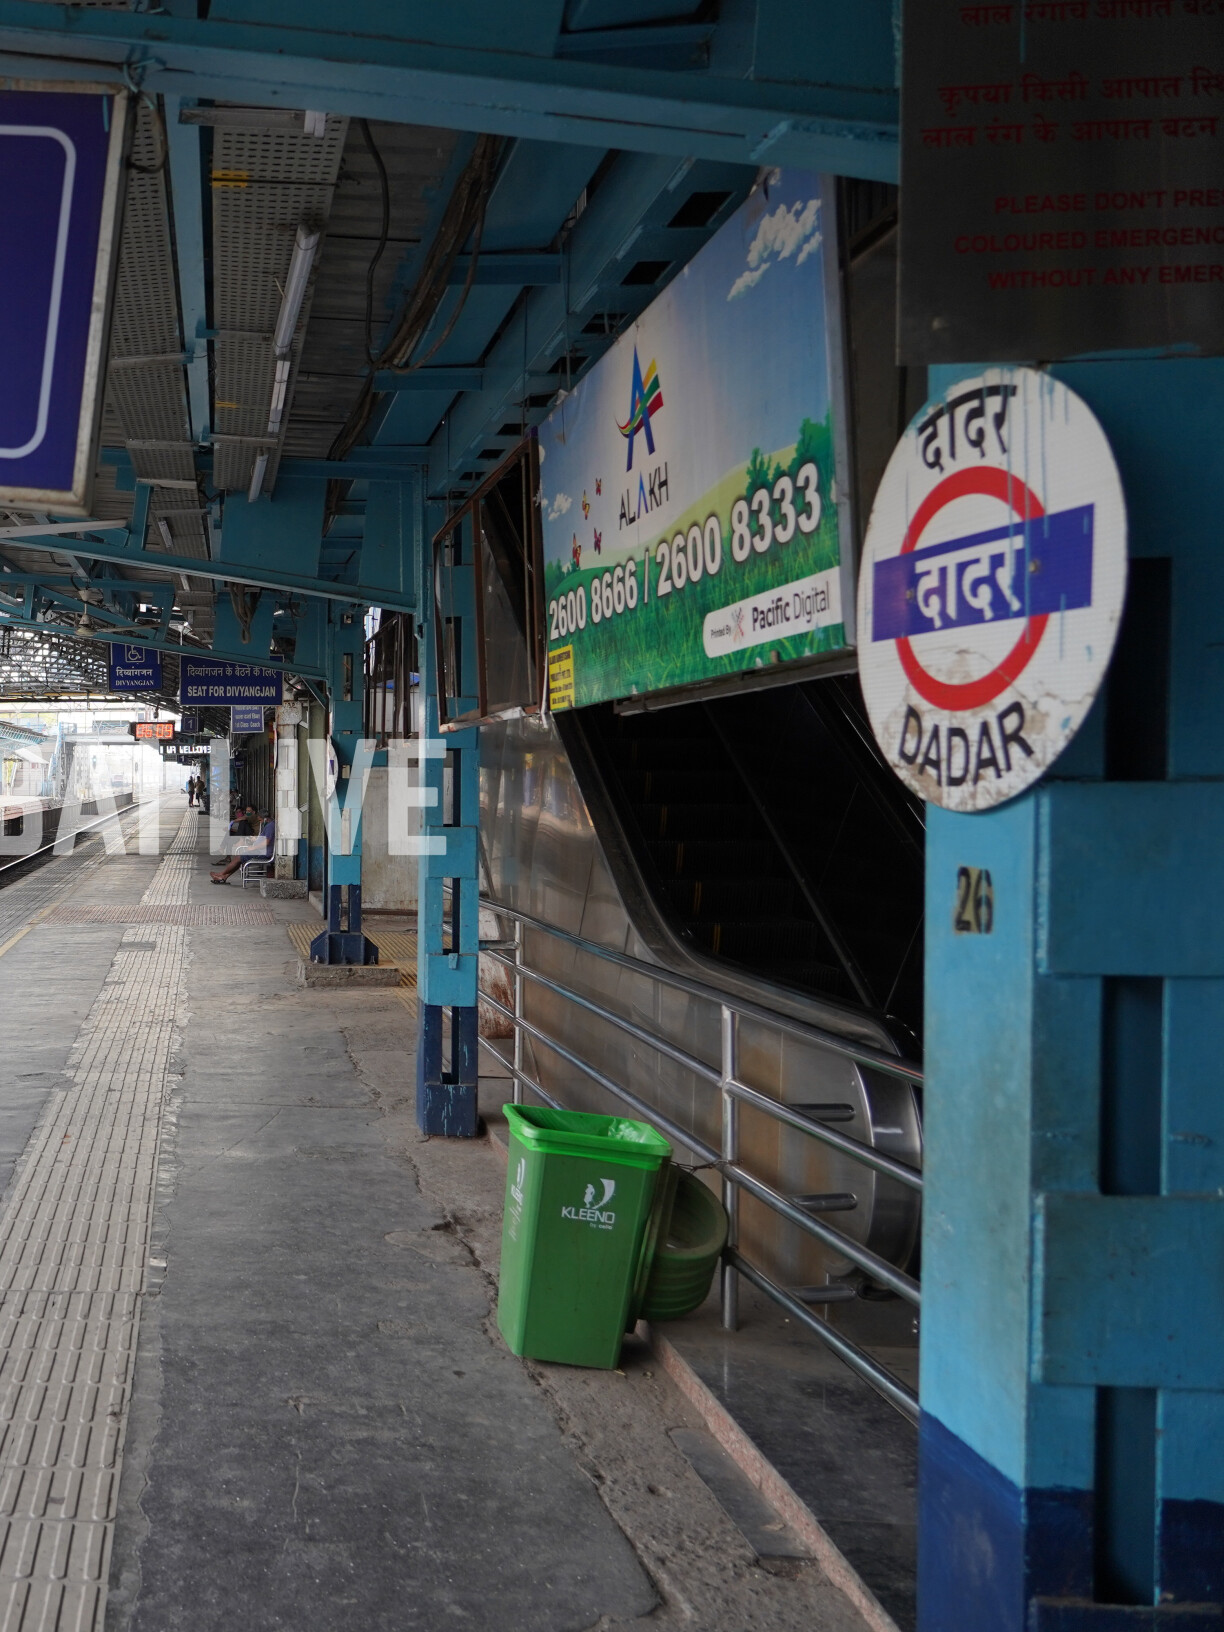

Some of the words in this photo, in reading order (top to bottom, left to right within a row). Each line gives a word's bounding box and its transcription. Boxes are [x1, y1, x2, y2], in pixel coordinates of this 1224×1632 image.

[1099, 77, 1184, 99] आपात
[921, 126, 977, 148] लाल
[984, 117, 1025, 144] रंग
[1030, 113, 1061, 142] के
[1070, 119, 1153, 142] आपात
[994, 193, 1088, 214] PLEASE
[1095, 191, 1168, 211] DON'T
[954, 230, 1087, 254] COLOURED
[987, 268, 1097, 289] WITHOUT
[1103, 266, 1152, 286] ANY
[917, 384, 1018, 474] दादर
[549, 585, 587, 641] 2600
[590, 556, 639, 625] 8666
[655, 514, 723, 598] 2600
[730, 461, 822, 563] 8333
[914, 534, 1025, 629] दादर
[751, 597, 791, 631] Pacific
[793, 580, 830, 624] Digital
[187, 686, 207, 697] SEAT
[209, 686, 224, 697] FOR
[226, 686, 276, 697] DIVYANGJAN
[898, 700, 1034, 788] DADAR
[954, 866, 994, 934] 26
[560, 1206, 616, 1224] KLEENO
